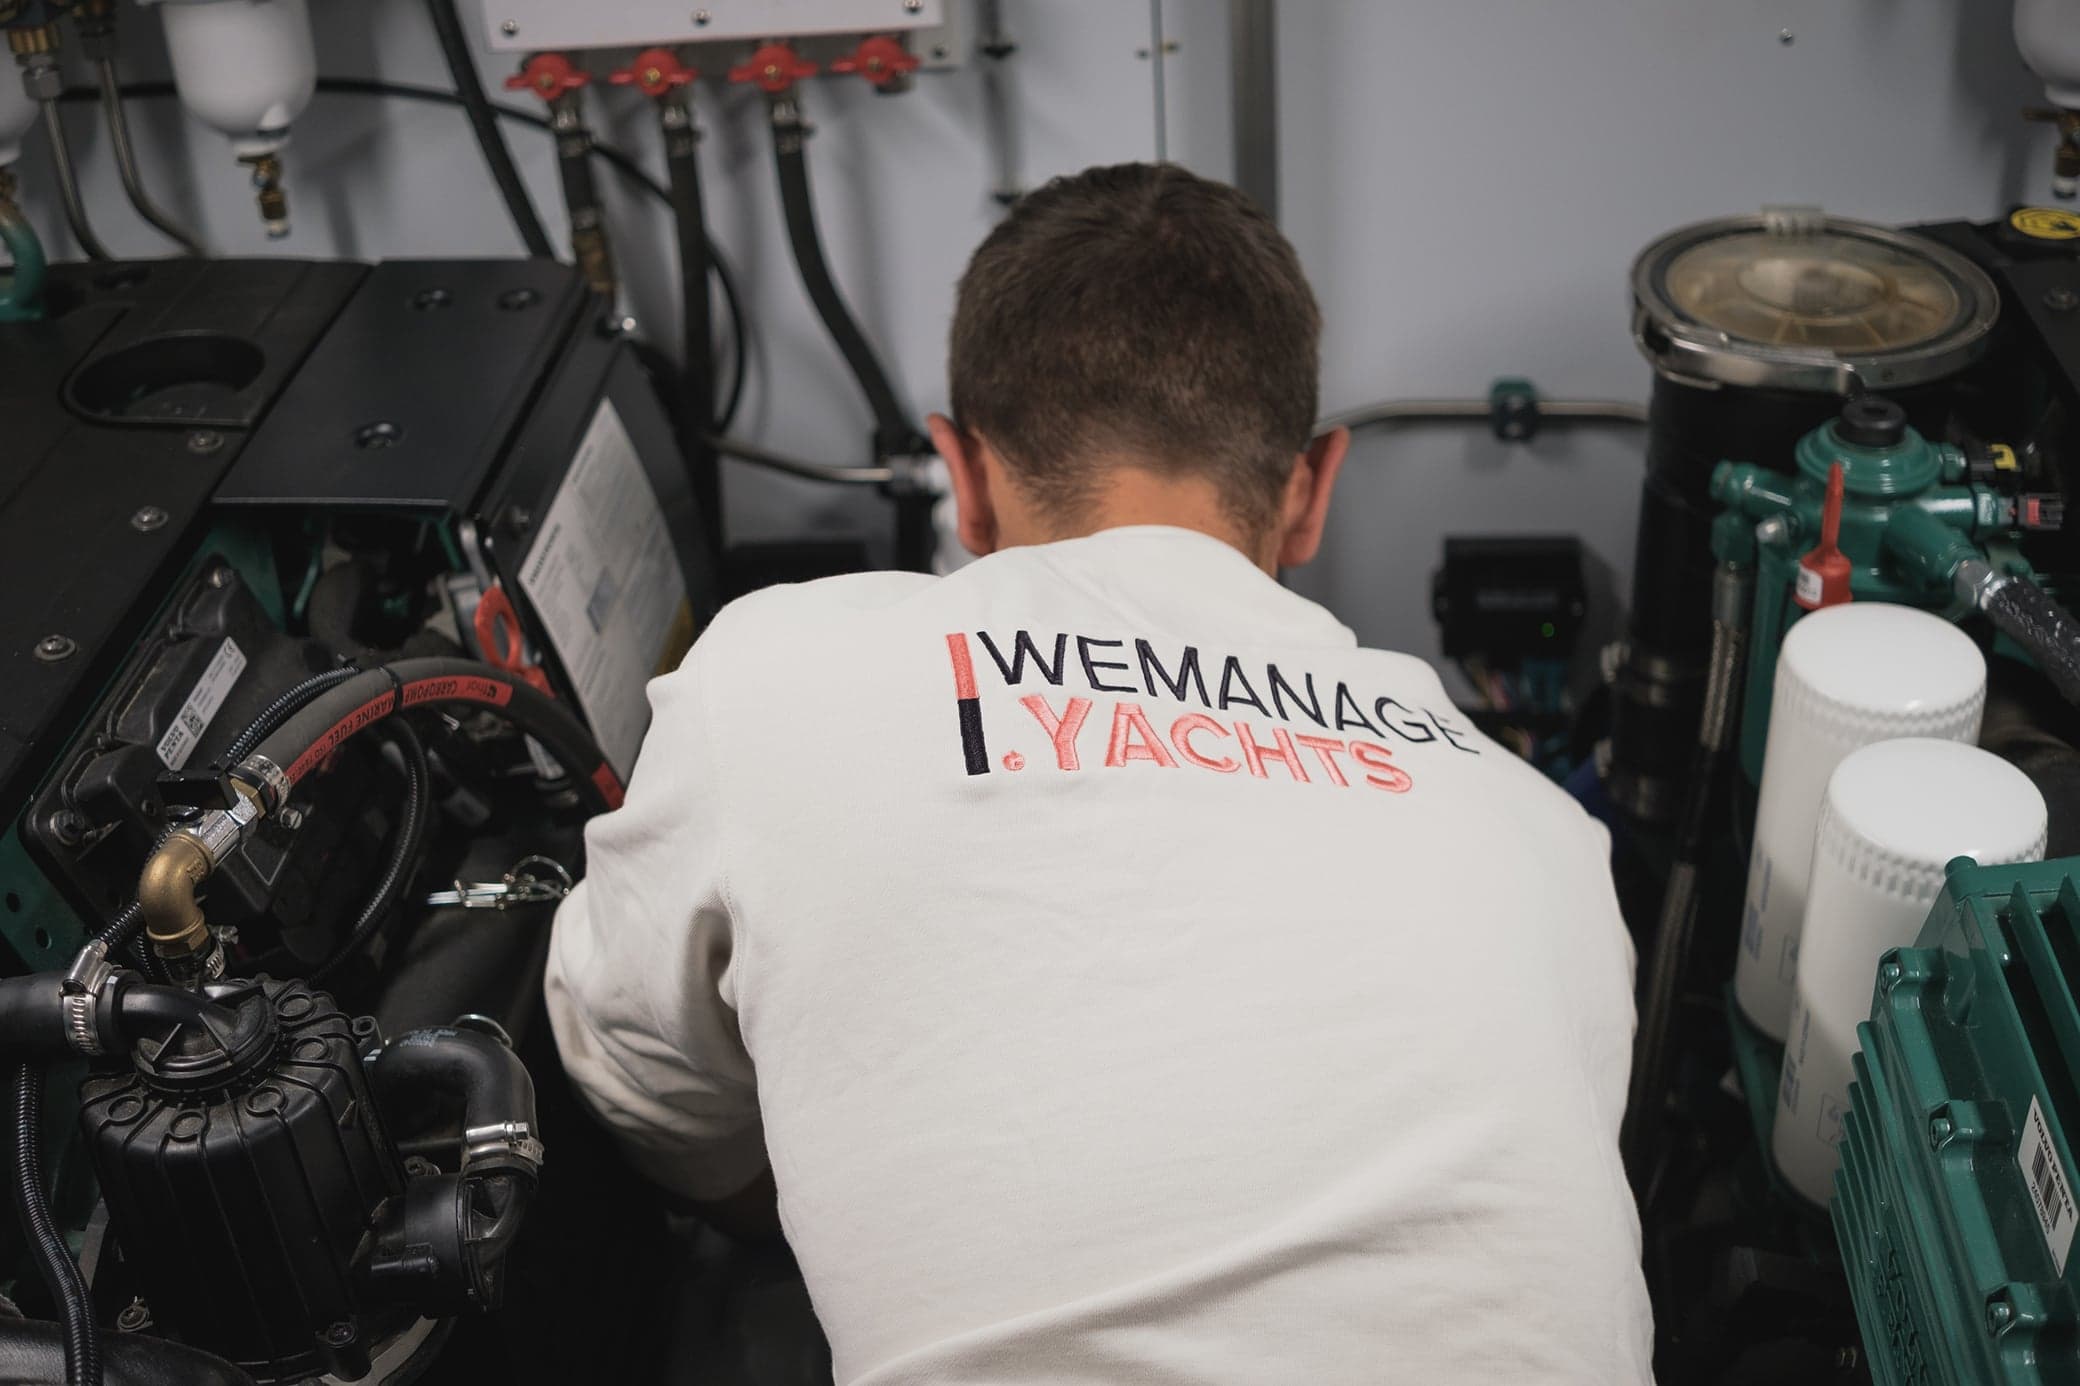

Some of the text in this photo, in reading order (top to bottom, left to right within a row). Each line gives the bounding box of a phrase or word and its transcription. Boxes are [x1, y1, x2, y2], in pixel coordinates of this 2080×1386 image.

[976, 630, 1480, 755] WEMANAGE
[163, 730, 184, 760] PENTA
[328, 720, 353, 745] FUEL
[2033, 1106, 2053, 1165] VOLVO
[2051, 1160, 2073, 1222] PENTA
